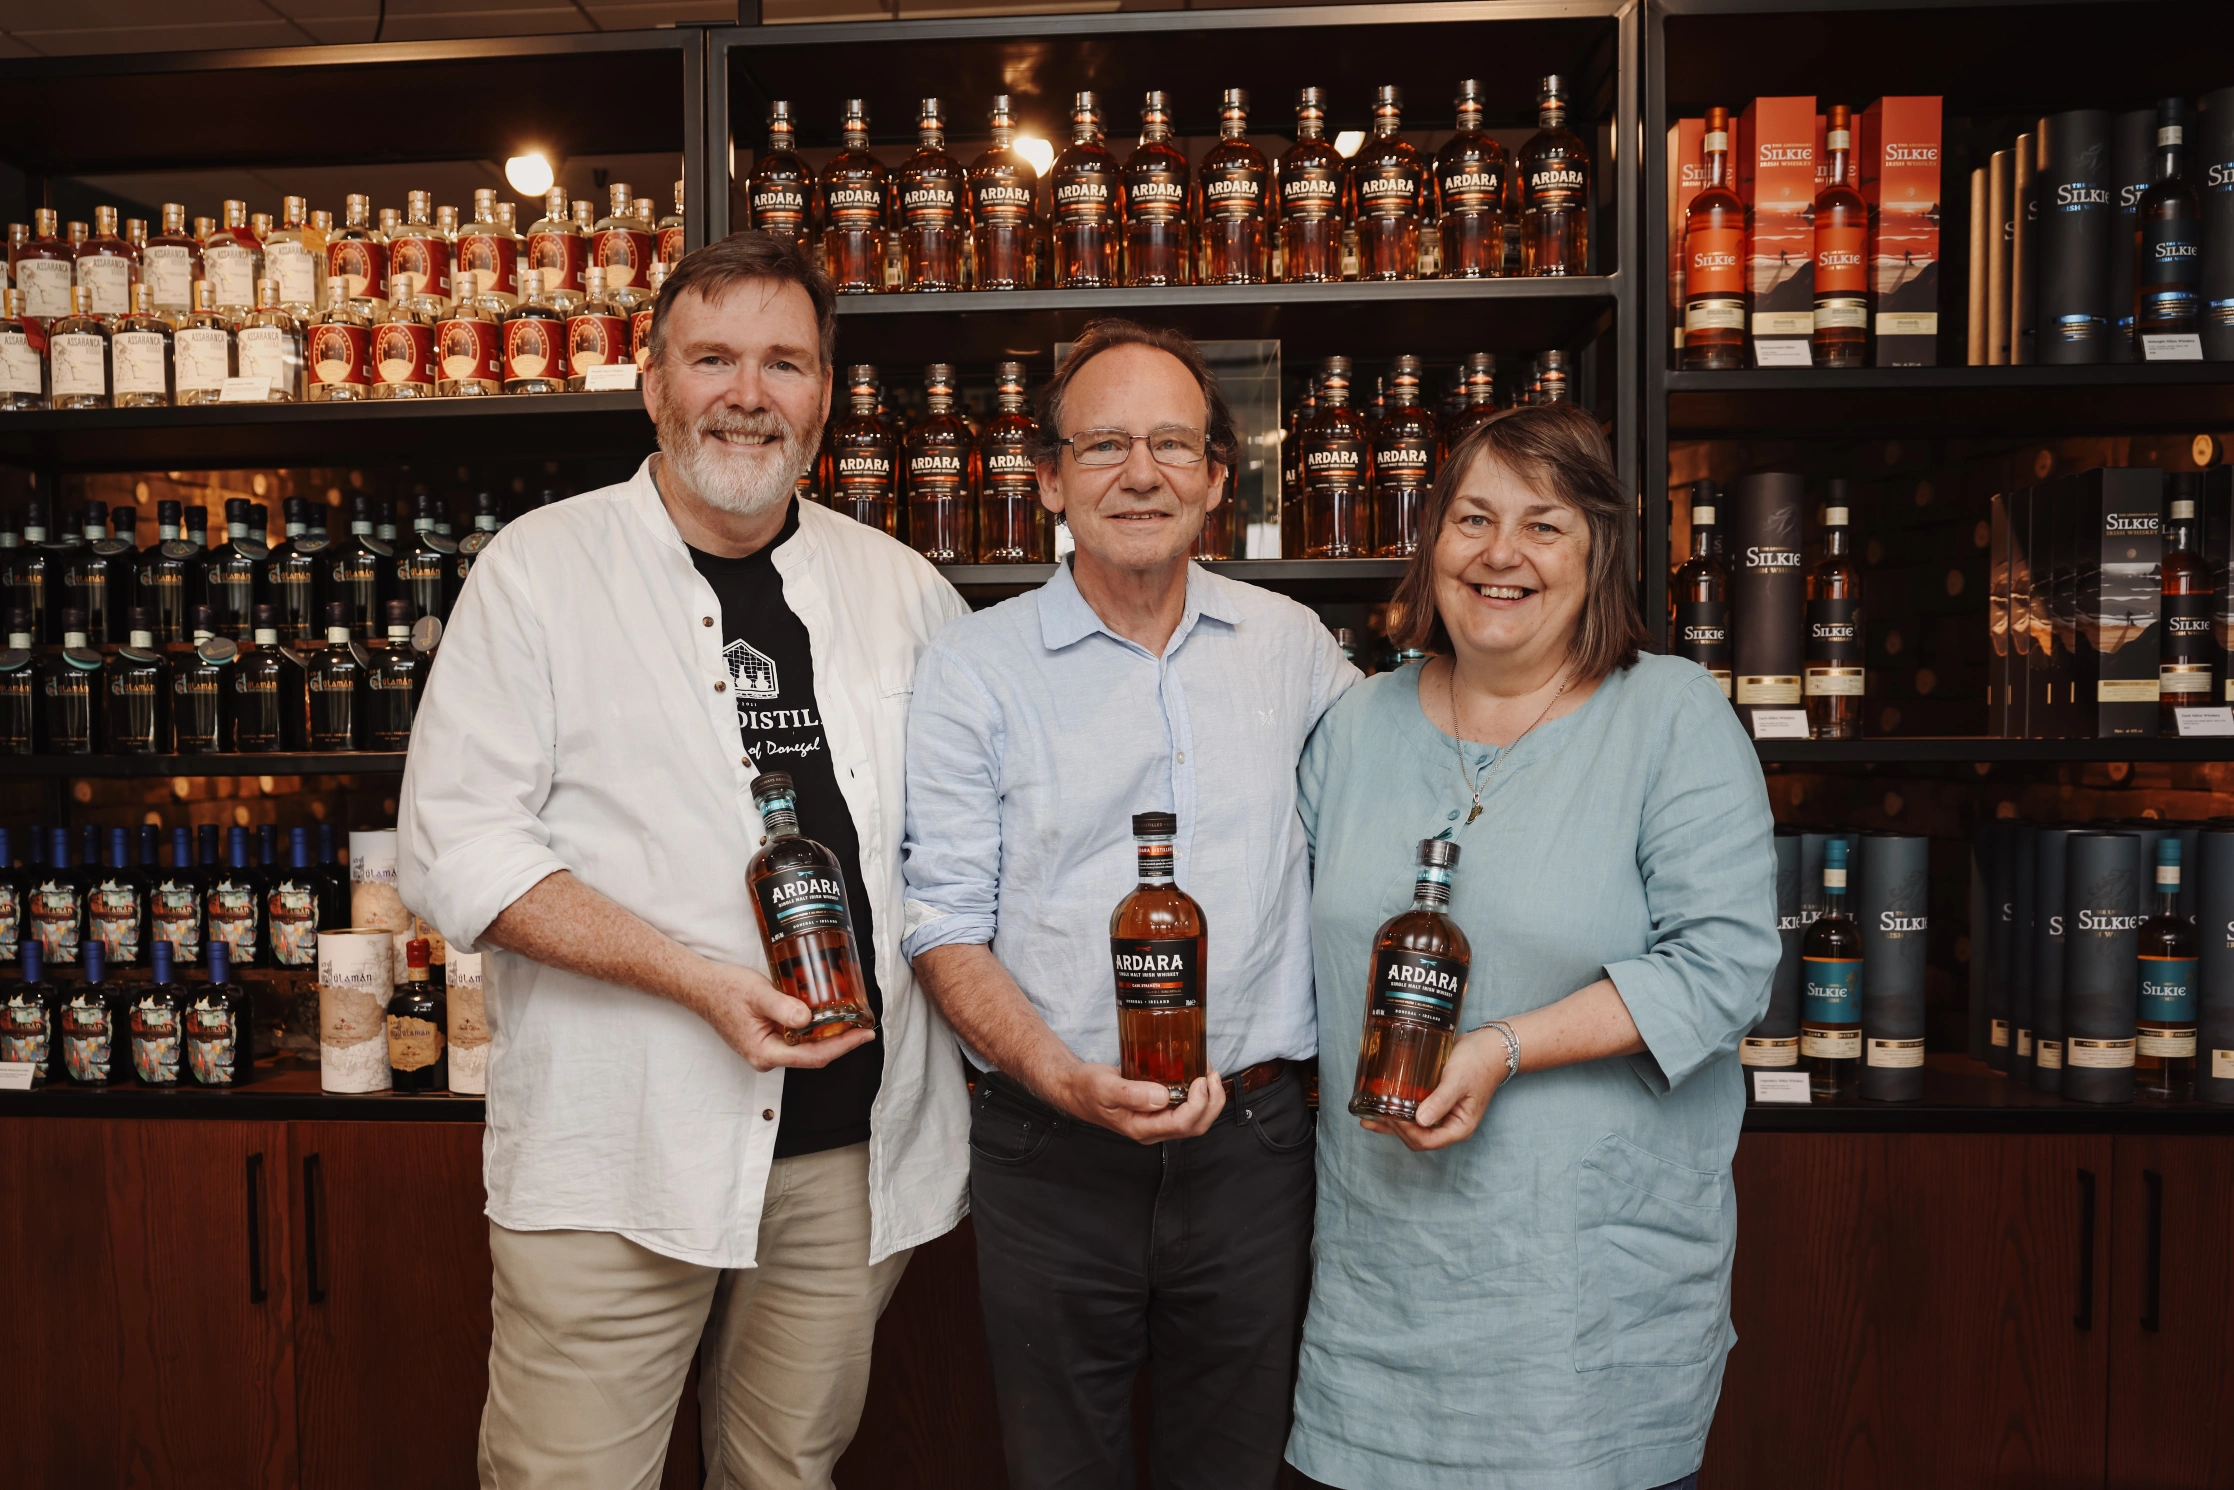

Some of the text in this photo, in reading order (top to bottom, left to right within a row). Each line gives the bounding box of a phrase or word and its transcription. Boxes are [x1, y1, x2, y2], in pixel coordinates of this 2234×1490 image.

[1760, 144, 1812, 160] SILKIE
[1886, 144, 1937, 160] SILKIE
[1445, 174, 1497, 189] ARDARA
[1532, 171, 1583, 186] ARDARA
[1058, 184, 1107, 199] ARDARA
[1132, 184, 1182, 198] ARDARA
[1208, 181, 1258, 195] ARDARA
[1285, 180, 1336, 195] ARDARA
[1363, 179, 1414, 194] ARDARA
[754, 193, 802, 207] ARDARA
[830, 190, 880, 204] ARDARA
[905, 190, 954, 204] ARDARA
[980, 187, 1030, 202] ARDARA
[2058, 184, 2110, 205] SILKIE
[2156, 243, 2197, 257] SILKIE
[1694, 253, 1735, 268] SILKIE
[1819, 252, 1860, 267] SILKIE
[5, 336, 27, 345] ASSARA
[912, 457, 960, 470] ARDARA
[989, 456, 1036, 468] ARDA
[1308, 452, 1358, 465] ARDARA
[1377, 450, 1427, 463] ARDARA
[840, 458, 889, 471] ARDARA
[2106, 514, 2158, 530] SILKIE
[1746, 547, 1800, 567] SILKIE
[1812, 624, 1853, 638] SILKIE
[2170, 617, 2210, 631] SILKIE
[1684, 626, 1724, 640] SILKIE
[738, 709, 819, 729] DISTIL
[748, 737, 820, 760] of Donegal
[772, 879, 840, 904] ARDARA
[1880, 912, 1928, 930] SILKIE
[2078, 910, 2136, 930] SILKIE
[1116, 955, 1183, 970] ARDARA
[1388, 965, 1457, 993] ARDARA
[1807, 983, 1847, 997] SILKIE
[2142, 982, 2186, 996] SILKIE
